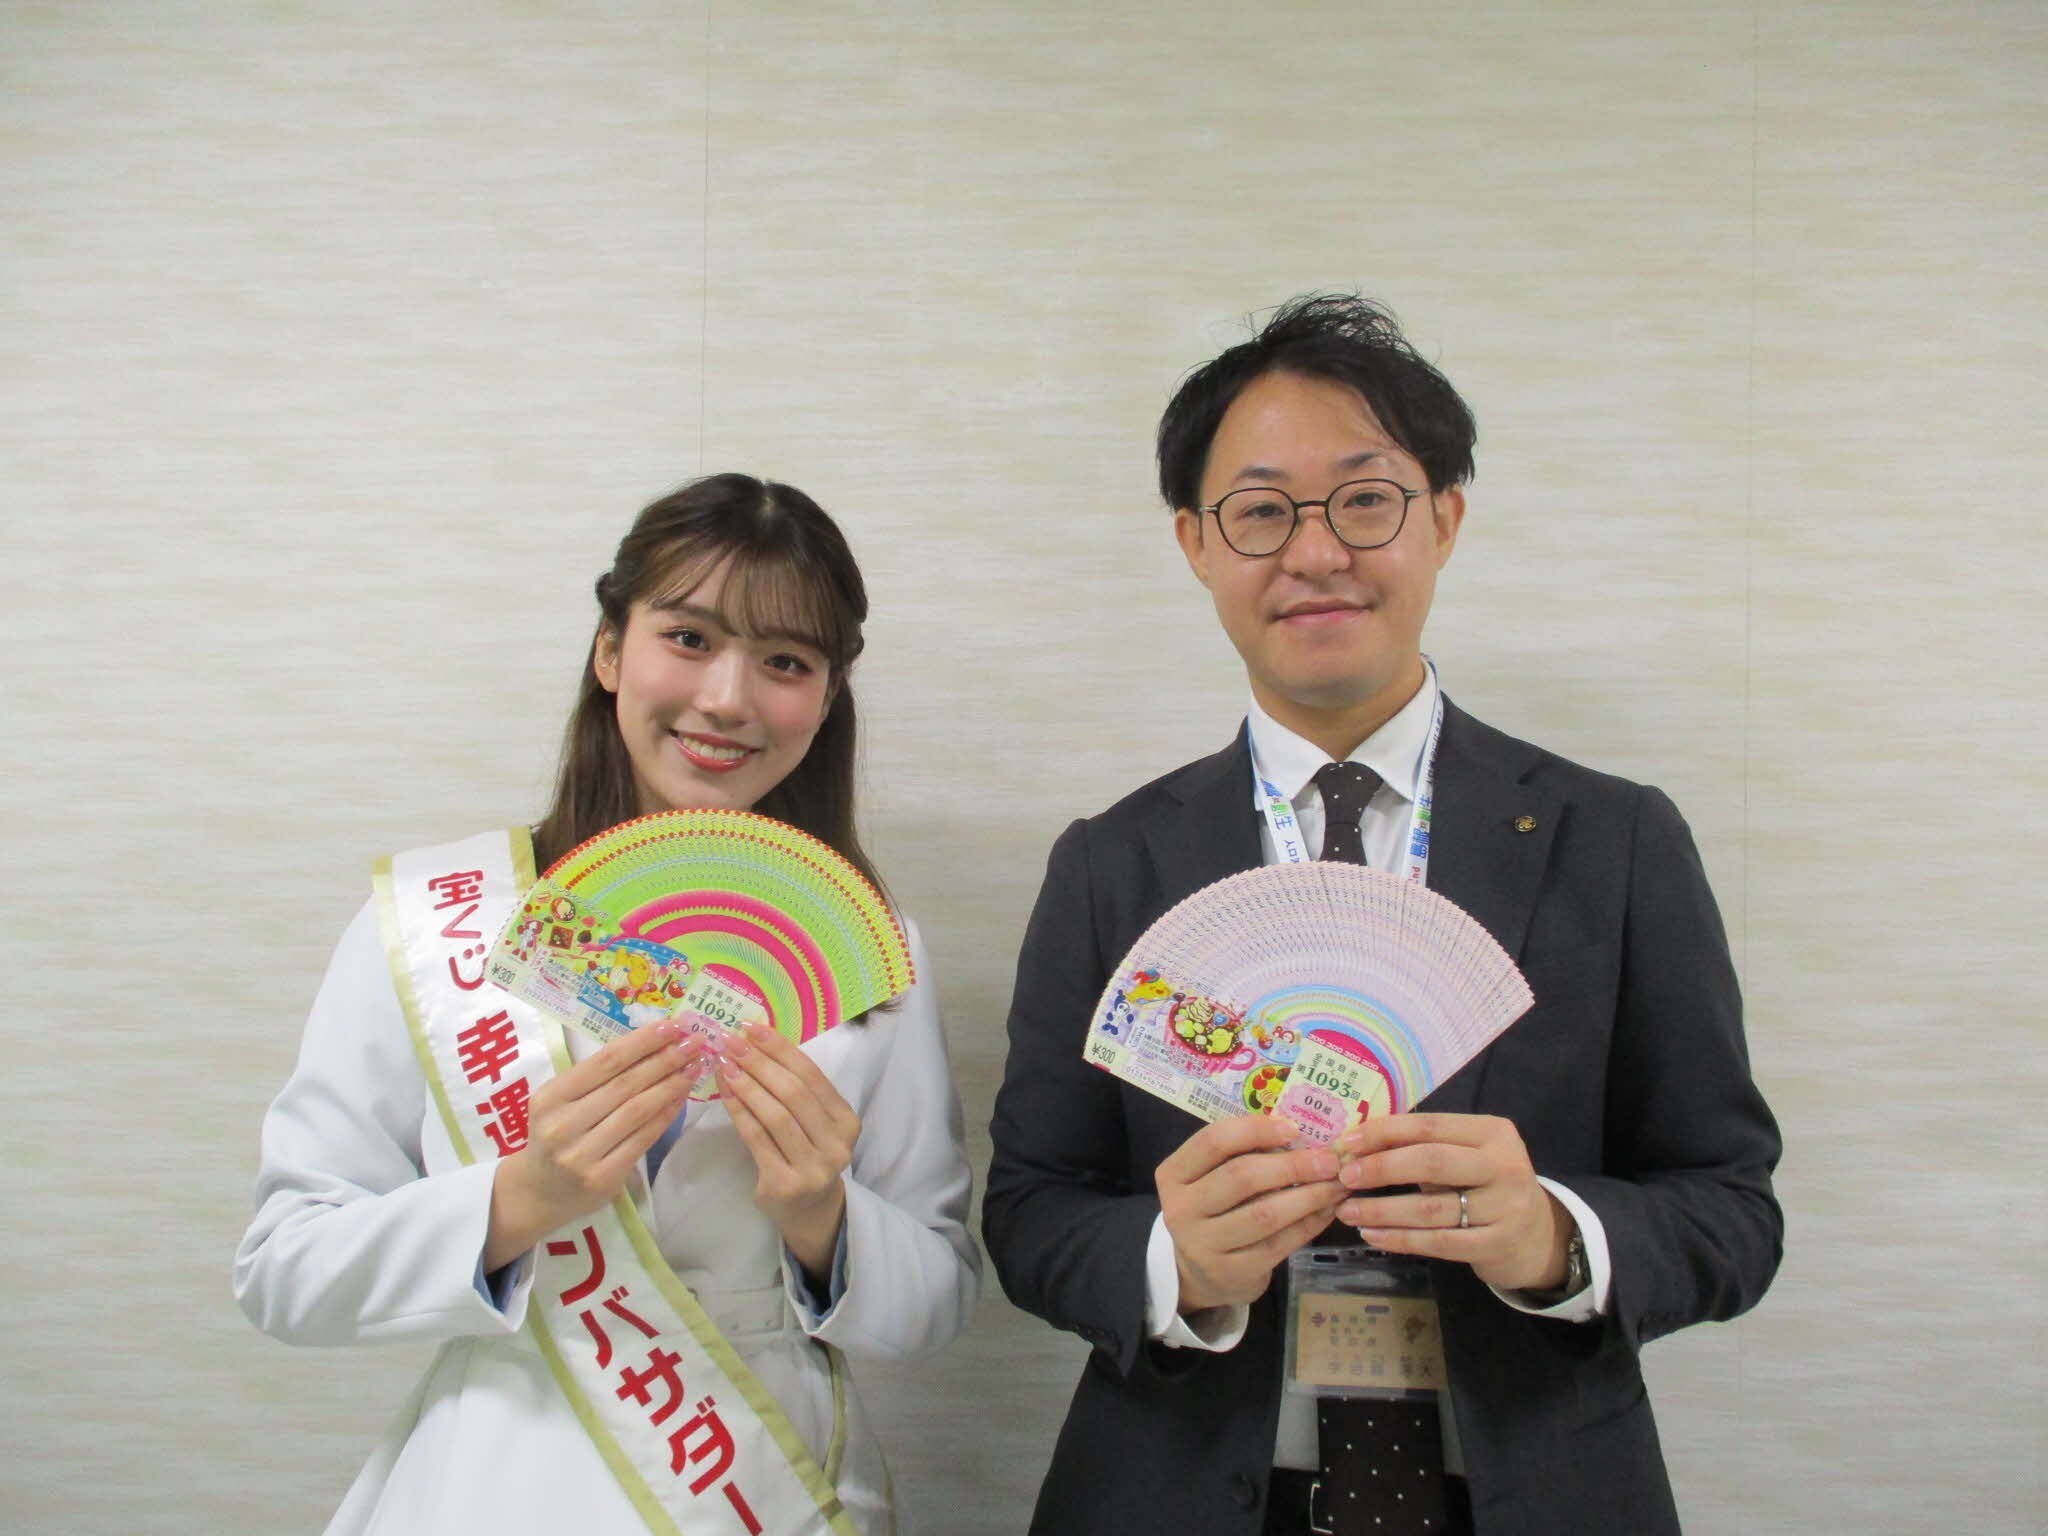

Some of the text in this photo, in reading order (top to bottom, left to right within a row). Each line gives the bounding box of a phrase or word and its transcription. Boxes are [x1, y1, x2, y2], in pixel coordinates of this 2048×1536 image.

[491, 963, 516, 985] ¥300
[428, 869, 529, 1158] 宝くじ 幸運
[1092, 1043, 1116, 1064] ¥300
